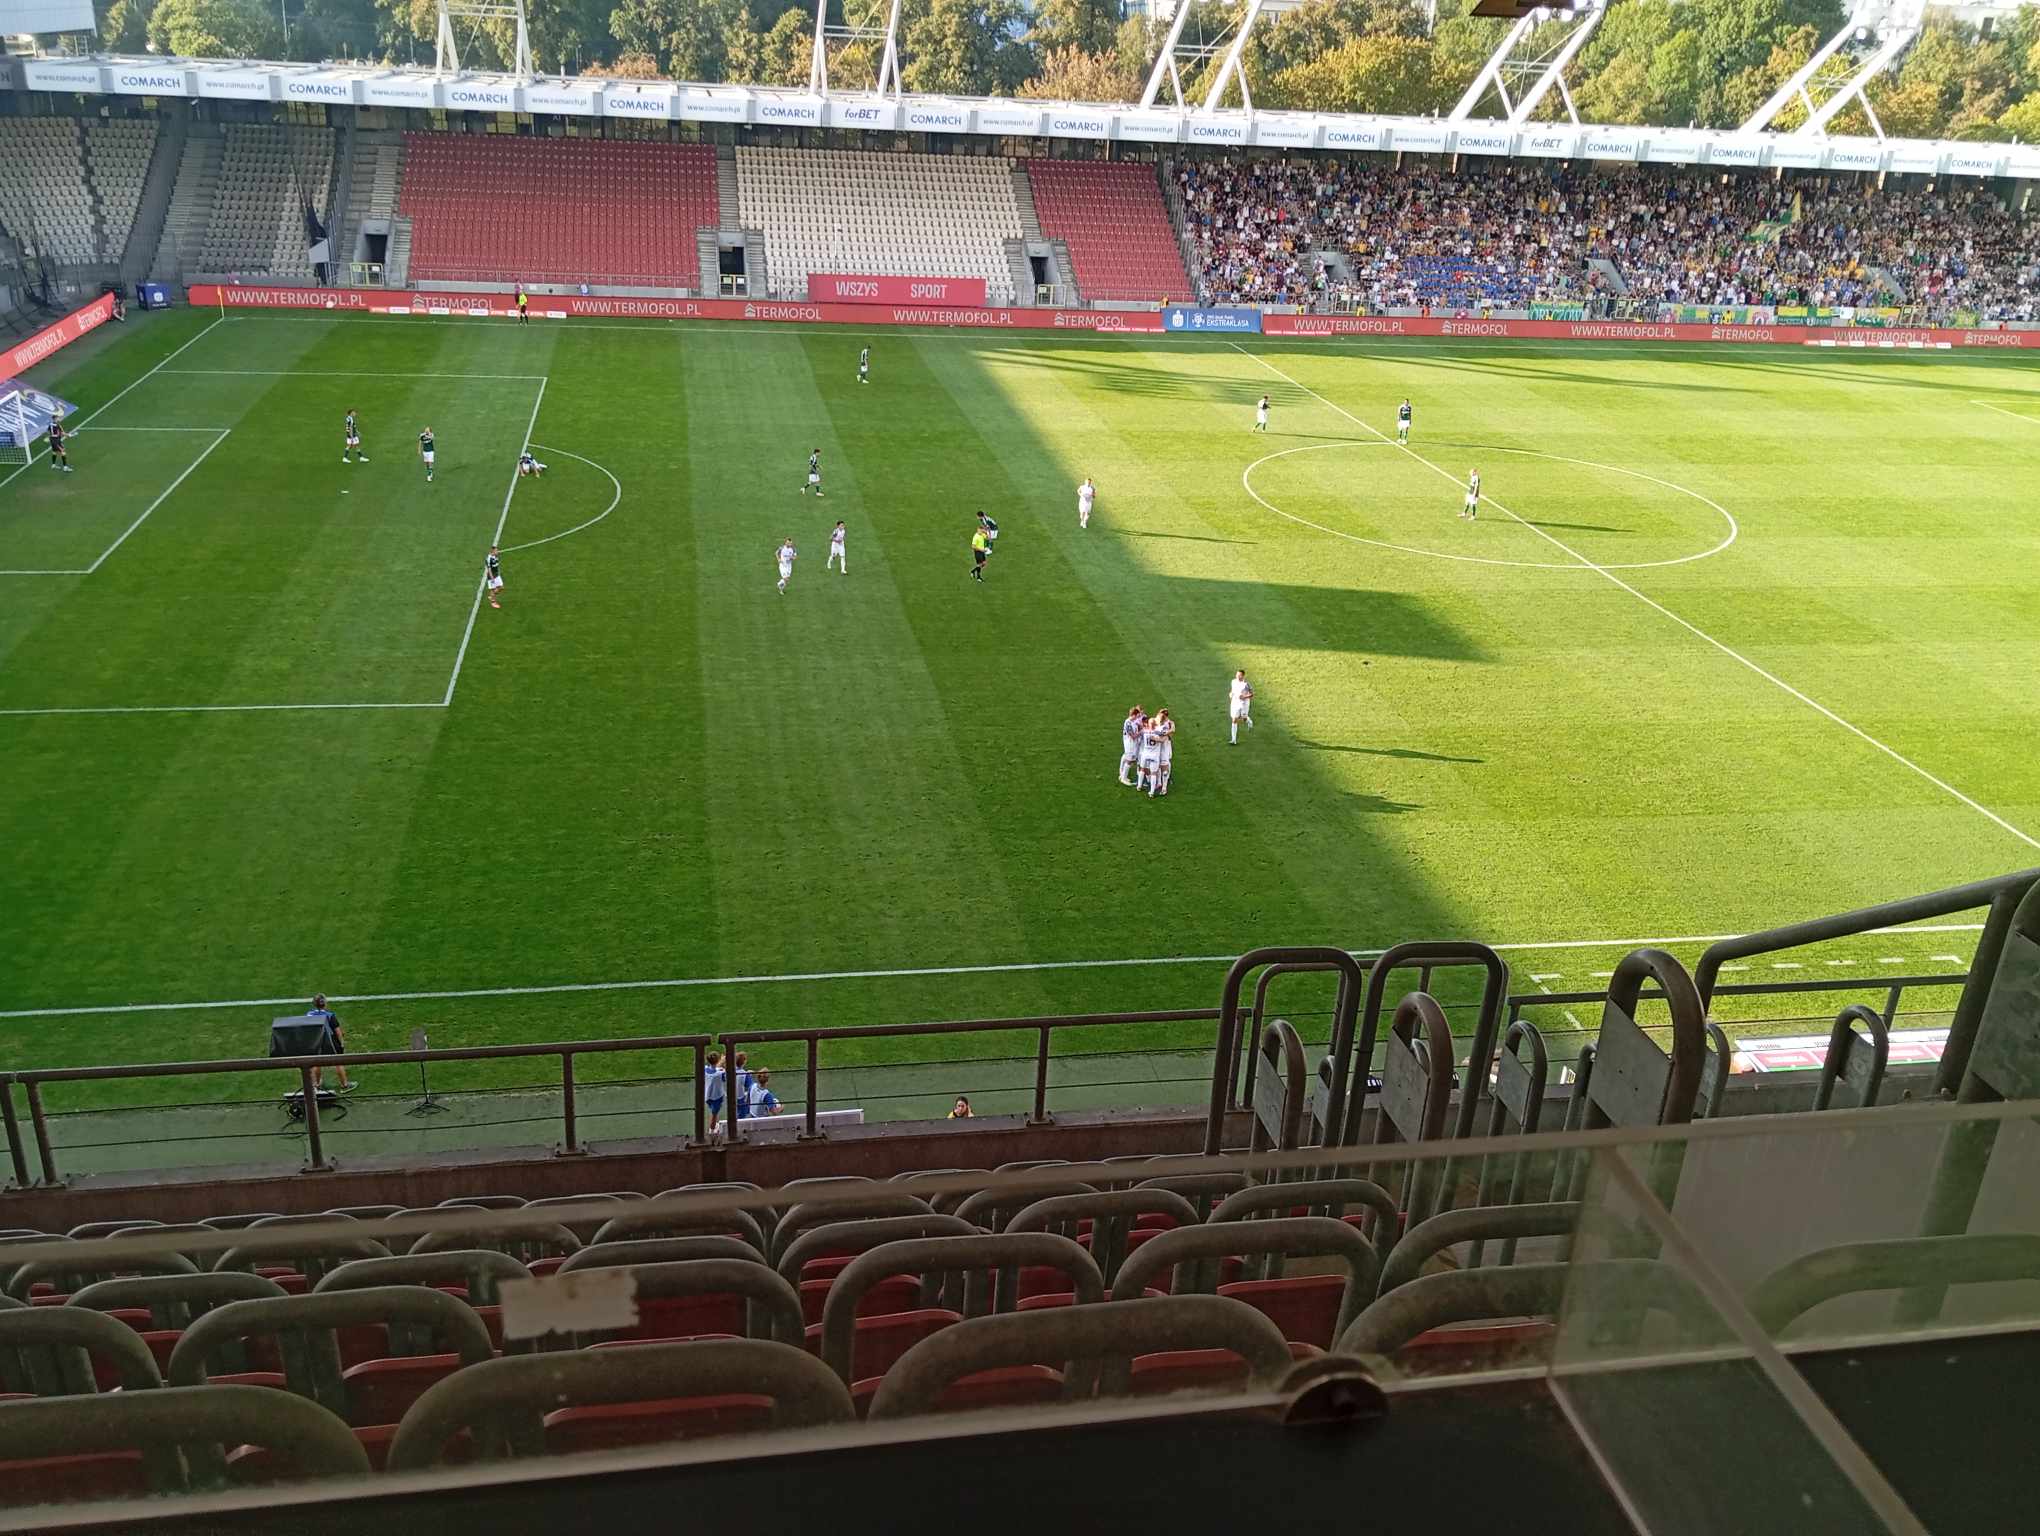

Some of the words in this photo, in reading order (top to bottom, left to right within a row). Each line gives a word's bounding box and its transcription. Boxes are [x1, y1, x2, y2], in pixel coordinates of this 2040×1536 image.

[121, 75, 181, 89] COMARCH
[288, 83, 347, 97] COMARCH
[451, 91, 508, 104] COMARCH
[609, 99, 665, 112] COMARCH
[761, 106, 815, 119] COMARCH
[843, 108, 881, 121] forBET
[910, 114, 962, 126] COMARCH
[1054, 120, 1104, 132] COMARCH
[1193, 127, 1241, 138] COMARCH
[1328, 132, 1375, 144] COMARCH
[1459, 138, 1506, 148] COMARCH
[1530, 138, 1563, 149] forBET
[1587, 143, 1632, 154] COMARCH
[1712, 148, 1756, 159] COMARCH
[1834, 154, 1877, 164] COMARCH
[1951, 159, 1993, 170] COMARCH
[835, 281, 879, 296] WSZYS
[911, 284, 947, 298] SPORT
[227, 289, 366, 308] WWW.TERMOFOL.PL
[425, 297, 495, 310] TERMOFOL
[572, 299, 702, 315] WWW.TERMOFOL.PL
[756, 305, 822, 320] TERMOFOL
[893, 309, 1014, 325] WWW.TERMOFOL.PL
[1065, 314, 1126, 328] TERMOFOL
[1294, 318, 1405, 333] WWW.TERMOFOL.PL
[1451, 322, 1508, 336] TERMOFOL
[1571, 325, 1676, 338] WWW.TERMOFOL.PL
[1720, 328, 1775, 341] TERMOFOL
